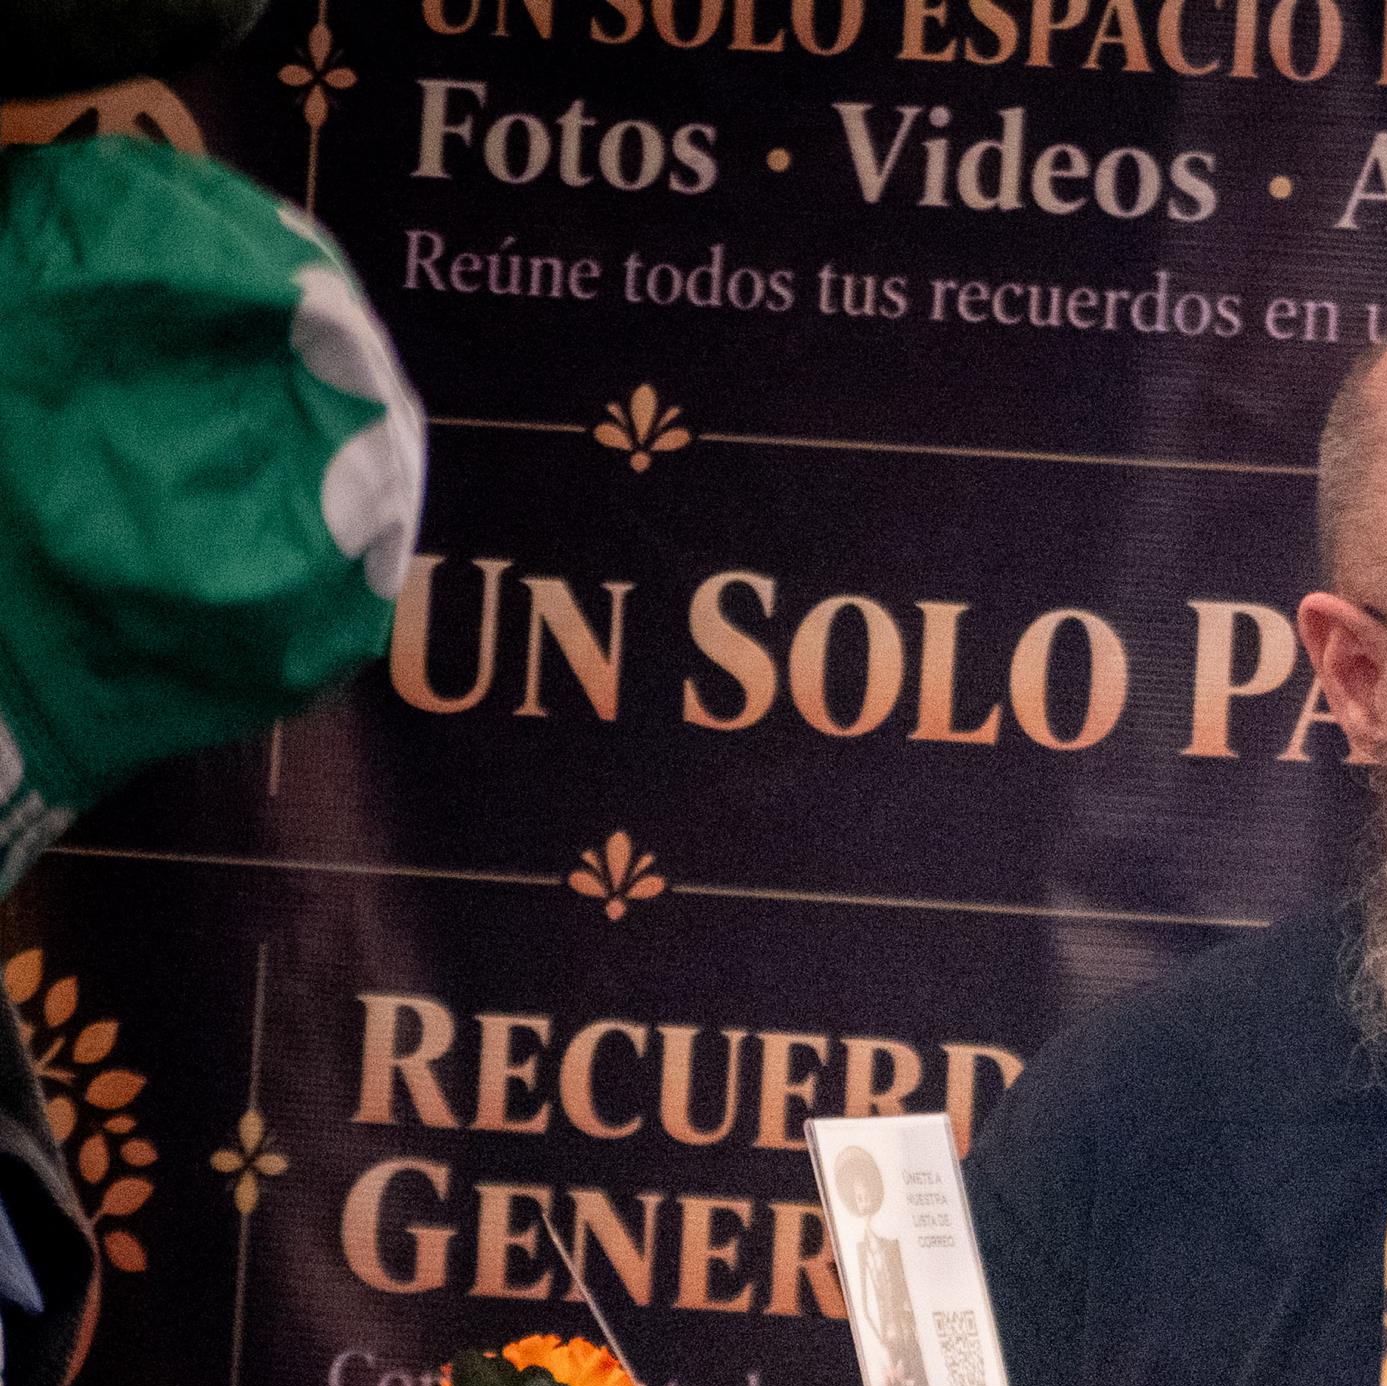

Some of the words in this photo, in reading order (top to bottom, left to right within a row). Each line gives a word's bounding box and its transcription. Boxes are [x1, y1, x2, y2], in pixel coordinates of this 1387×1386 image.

[897, 0, 1343, 82] ESPACIO
[410, 79, 718, 194] Fotos
[831, 103, 1217, 222] Videos
[403, 230, 601, 300] Reúne
[624, 244, 795, 312] todos
[818, 263, 907, 319] tus
[930, 270, 1242, 338] recuerdos
[1265, 299, 1339, 343] en
[390, 554, 636, 722] UN
[682, 570, 1129, 751] SOLO
